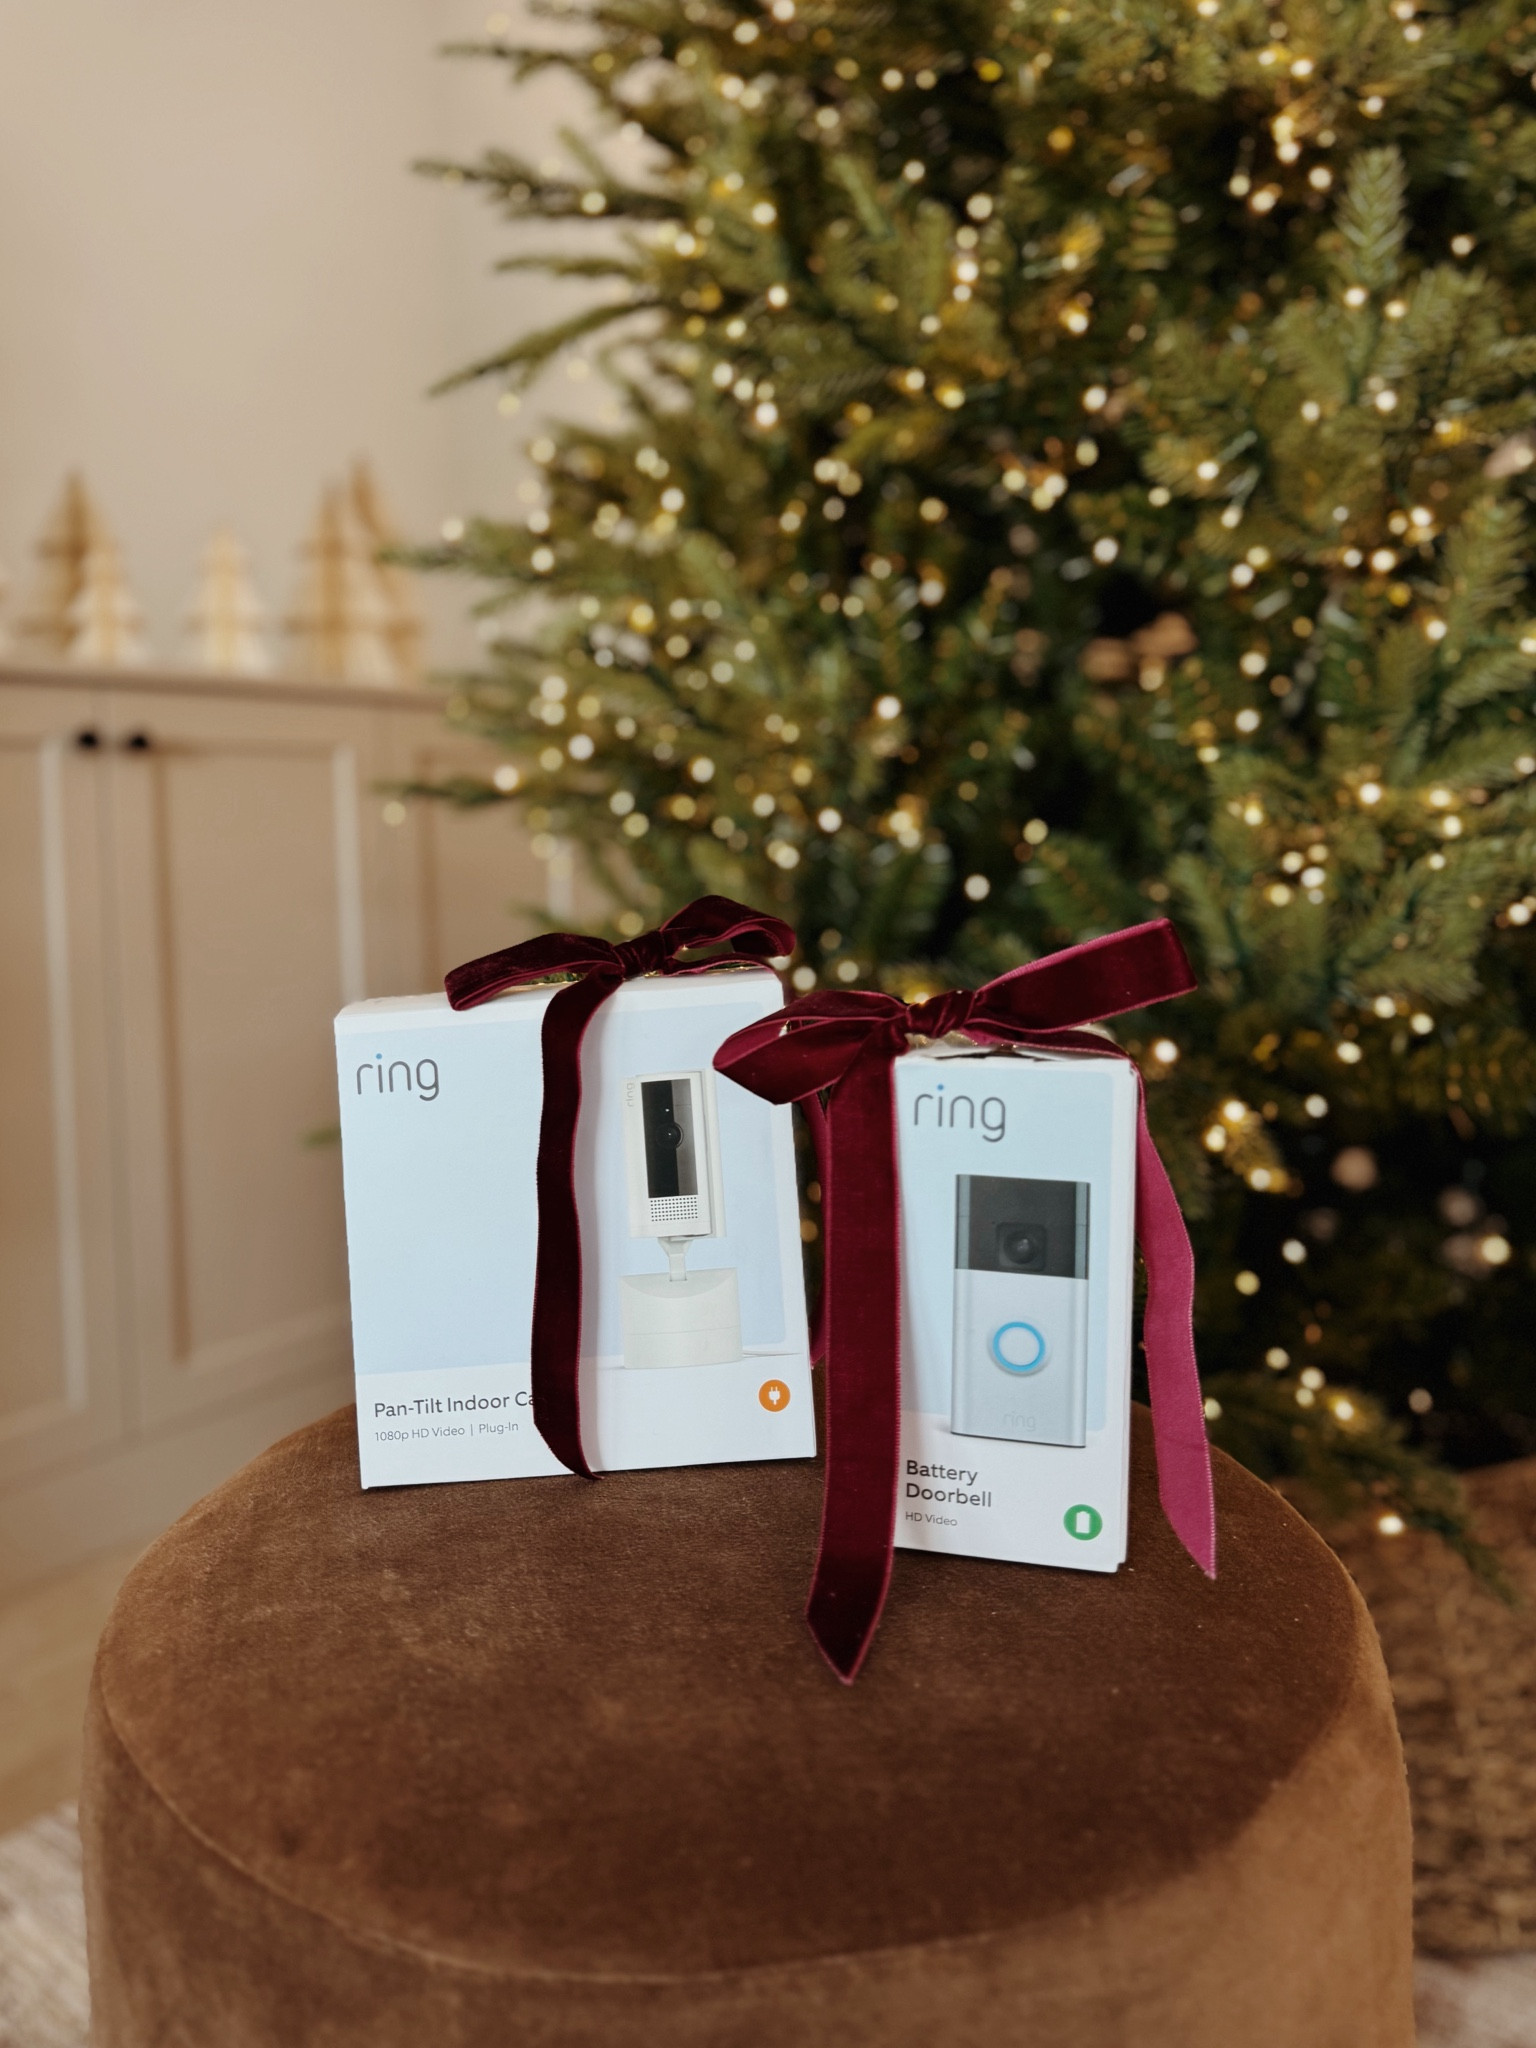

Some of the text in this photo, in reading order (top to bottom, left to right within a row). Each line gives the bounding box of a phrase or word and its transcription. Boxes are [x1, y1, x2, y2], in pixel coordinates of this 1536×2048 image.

[356, 1053, 440, 1102] ring
[914, 1083, 1006, 1143] ring
[375, 1398, 442, 1417] Pan-Tilt
[448, 1395, 510, 1412] Indoor
[375, 1430, 410, 1442] 1080p
[411, 1427, 430, 1439] HD
[431, 1426, 466, 1437] Video
[479, 1421, 519, 1434] Plug-In
[906, 1460, 978, 1486] Battery
[906, 1483, 992, 1507] Doorbell
[905, 1511, 958, 1527] HD Video
